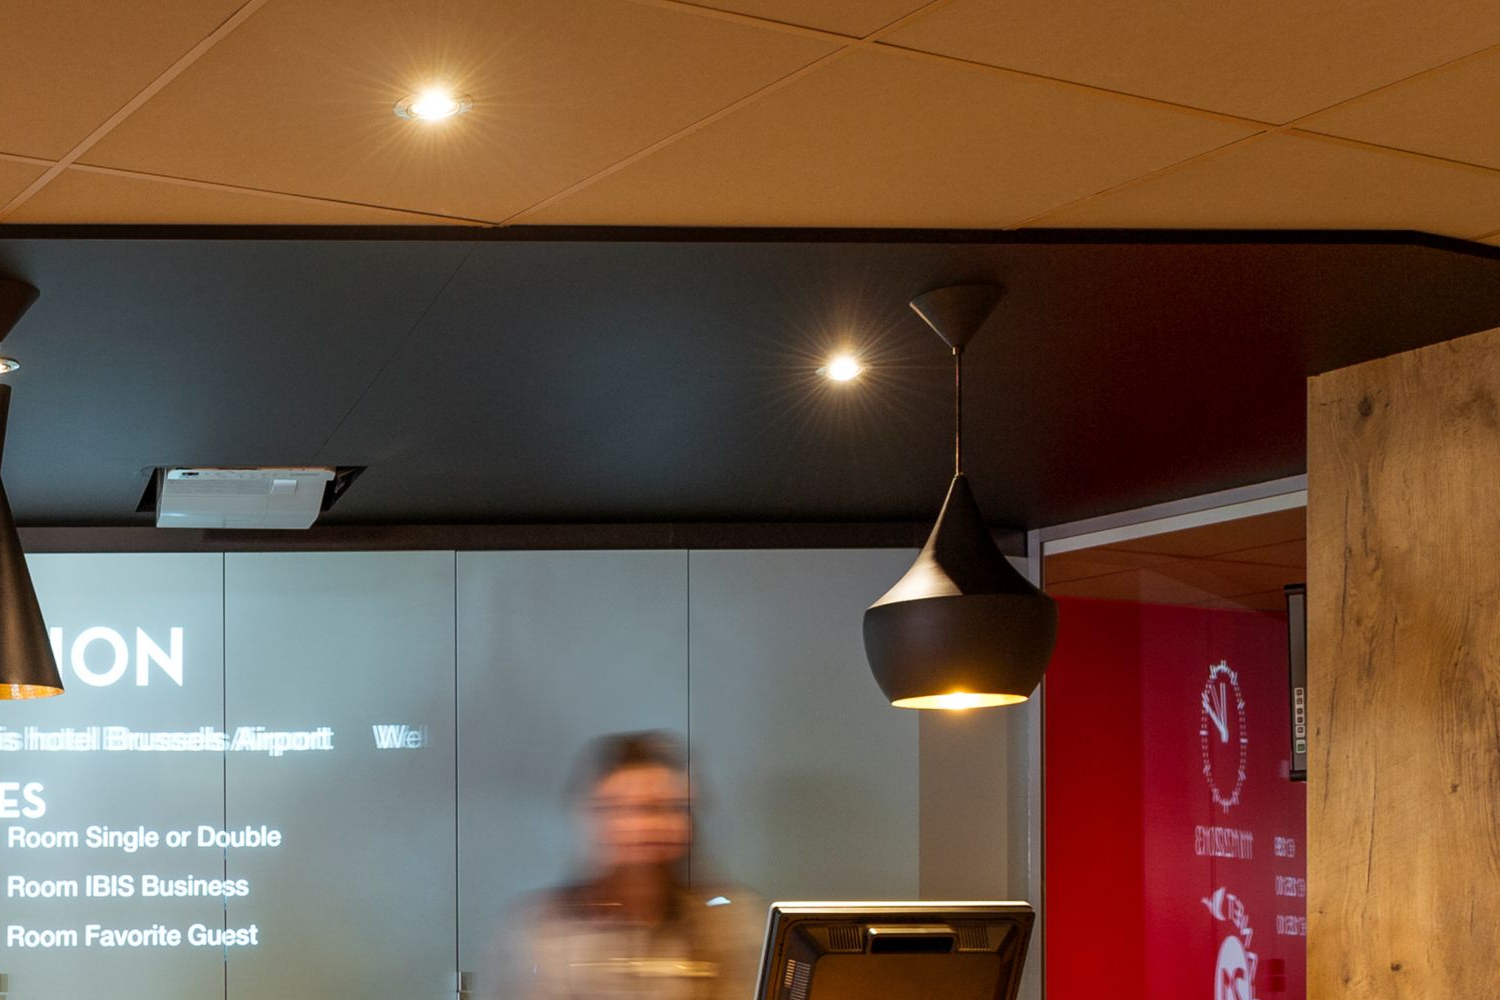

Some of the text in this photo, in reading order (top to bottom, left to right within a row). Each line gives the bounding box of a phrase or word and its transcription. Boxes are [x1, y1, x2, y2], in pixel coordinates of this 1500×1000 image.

[24, 726, 100, 752] hotel
[102, 725, 230, 752] Brussels
[231, 725, 334, 757] Airport
[7, 825, 282, 853] Room Single or Double
[7, 874, 250, 898] Room IBIS Business
[6, 923, 259, 948] Room Favorite Guest
